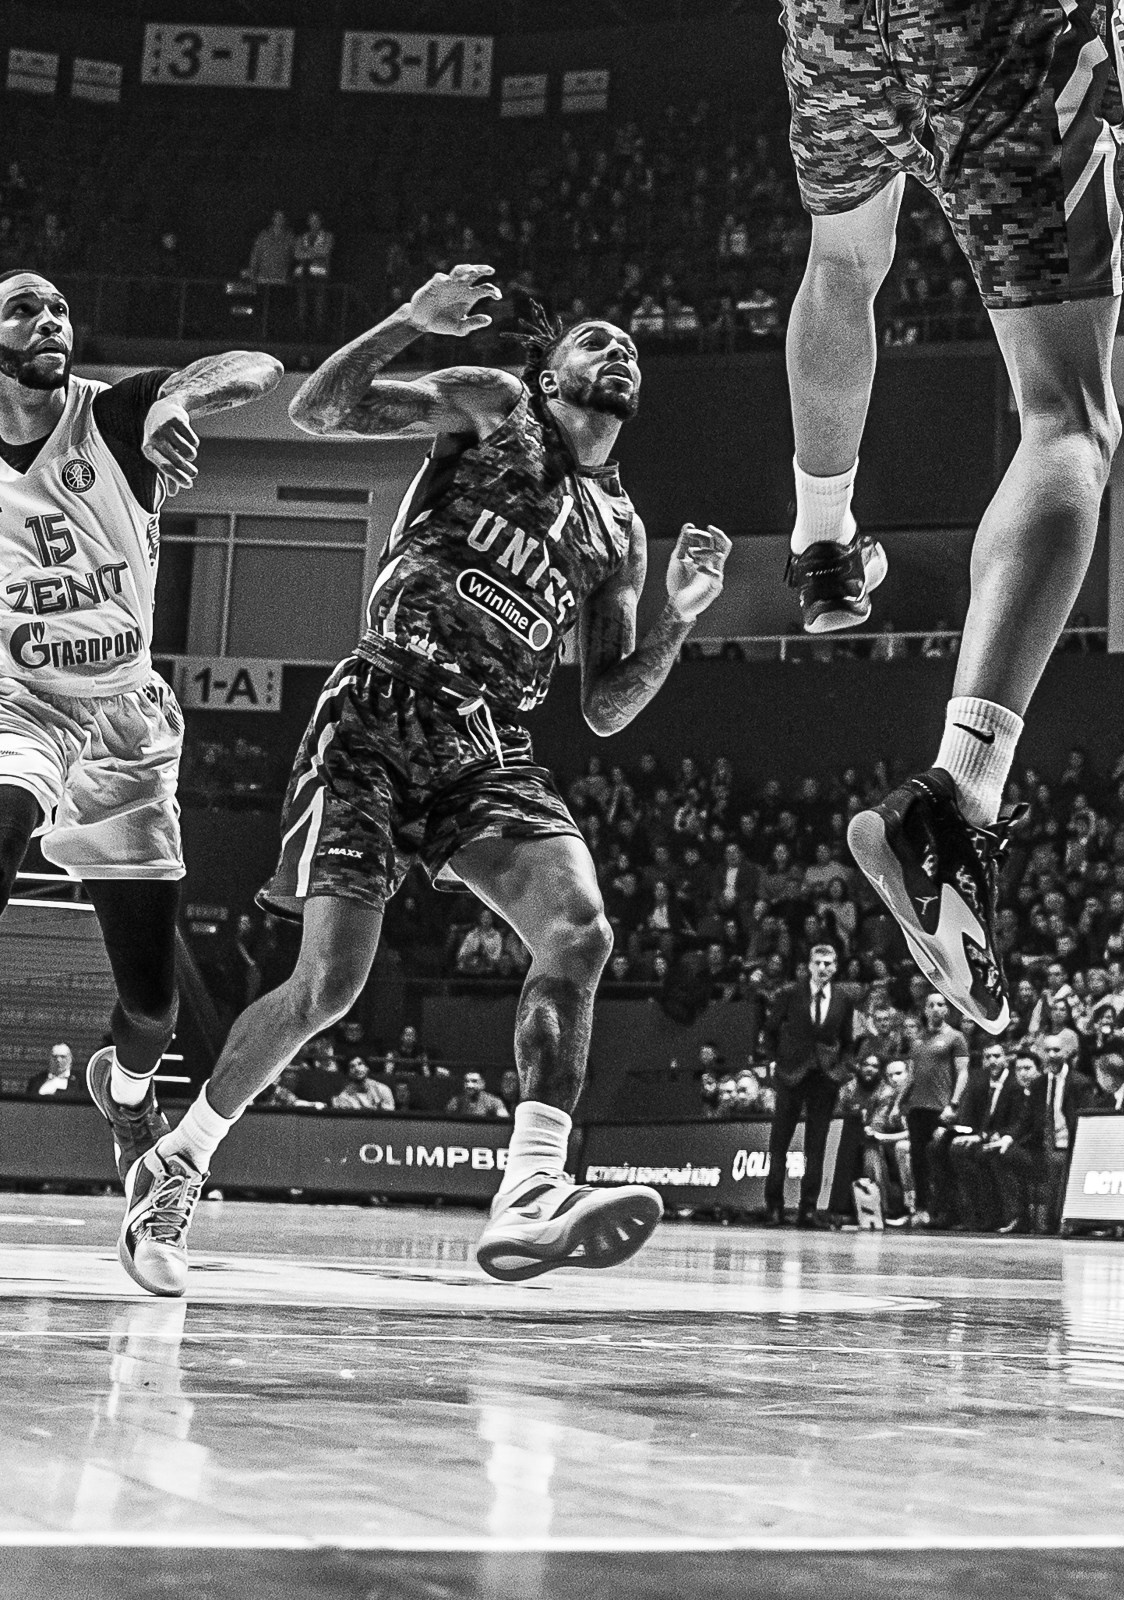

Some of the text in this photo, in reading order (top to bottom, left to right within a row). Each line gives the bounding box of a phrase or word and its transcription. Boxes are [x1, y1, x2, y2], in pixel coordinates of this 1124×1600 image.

[167, 32, 270, 82] 3-Т
[369, 37, 464, 89] 3-И
[25, 512, 77, 568] 15
[6, 561, 128, 615] ZENIT
[51, 626, 142, 668] ГАЗПРОМ
[359, 1143, 511, 1170] OLIMPBE
